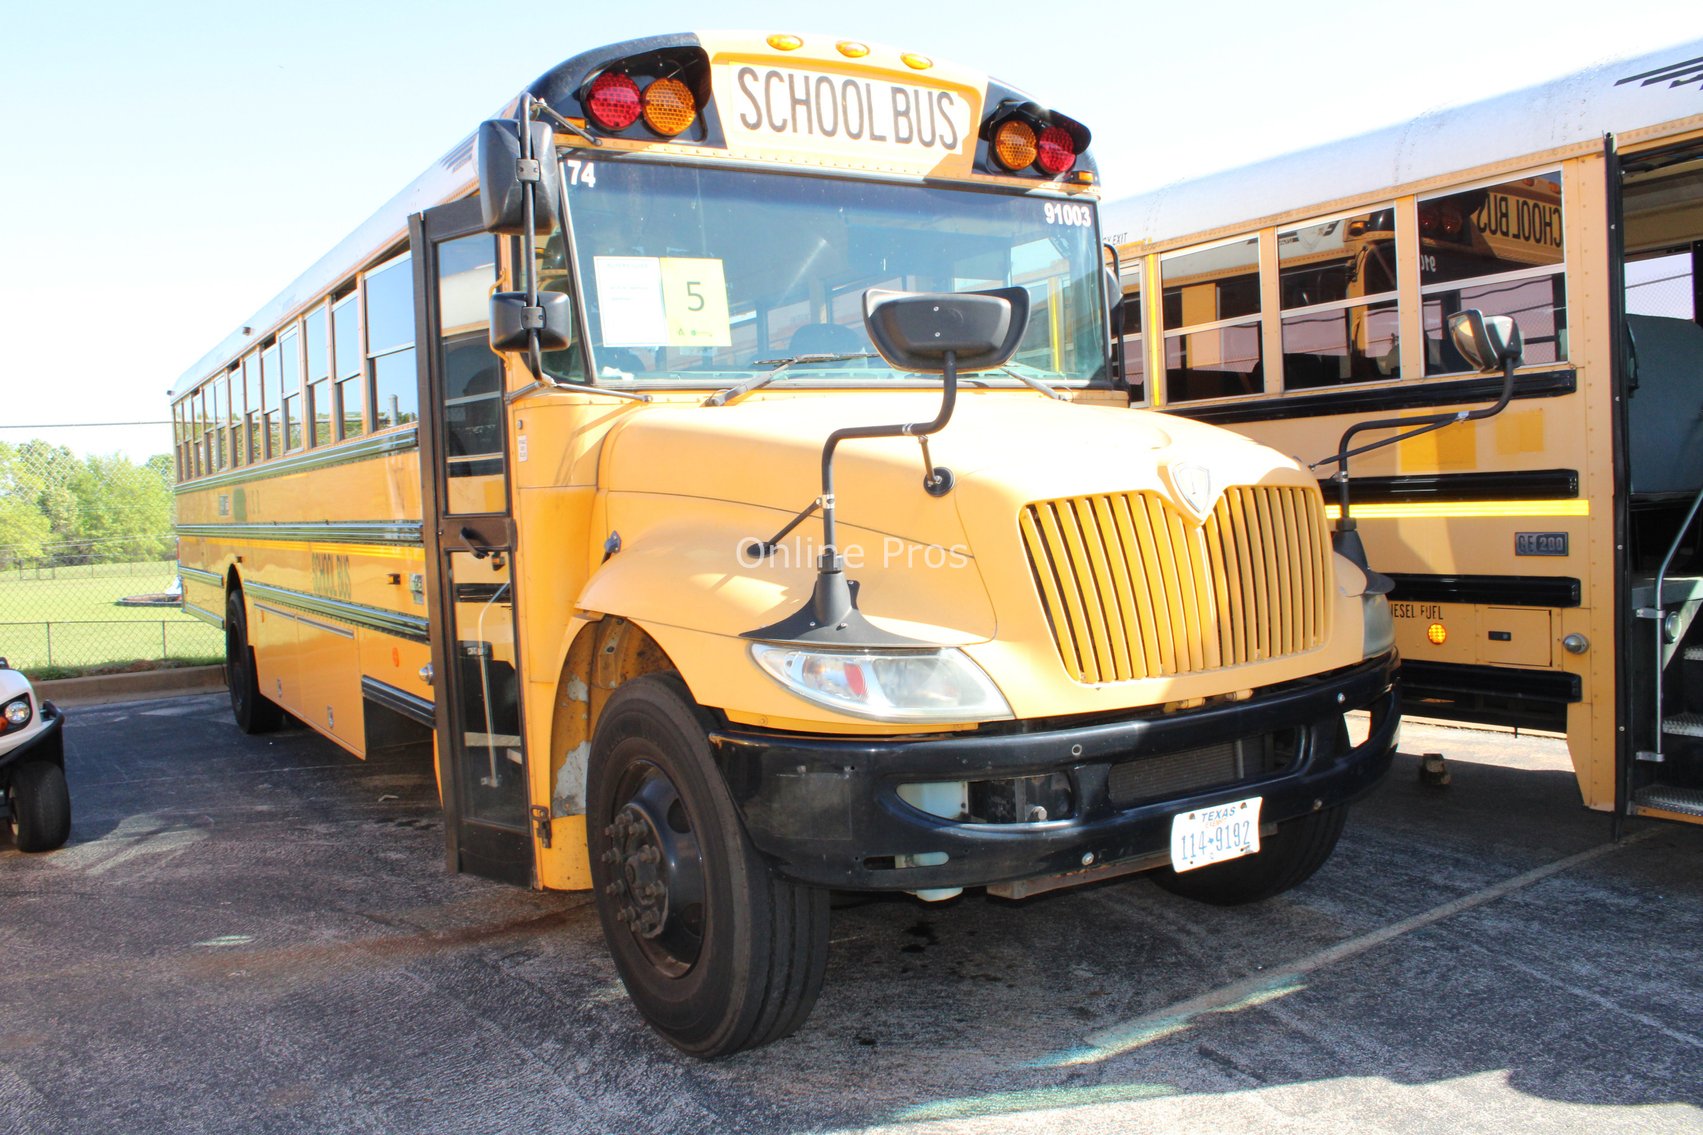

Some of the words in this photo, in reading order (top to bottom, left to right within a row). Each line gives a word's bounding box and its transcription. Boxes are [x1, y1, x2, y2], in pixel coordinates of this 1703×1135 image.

[737, 66, 887, 142] SCHOOL
[890, 86, 958, 150] BUS
[567, 159, 596, 188] 74
[1044, 202, 1091, 227] 91003
[686, 281, 705, 311] 5
[1390, 603, 1415, 618] IESEL
[1420, 604, 1444, 620] FUEL
[1201, 806, 1237, 822] TEXAS
